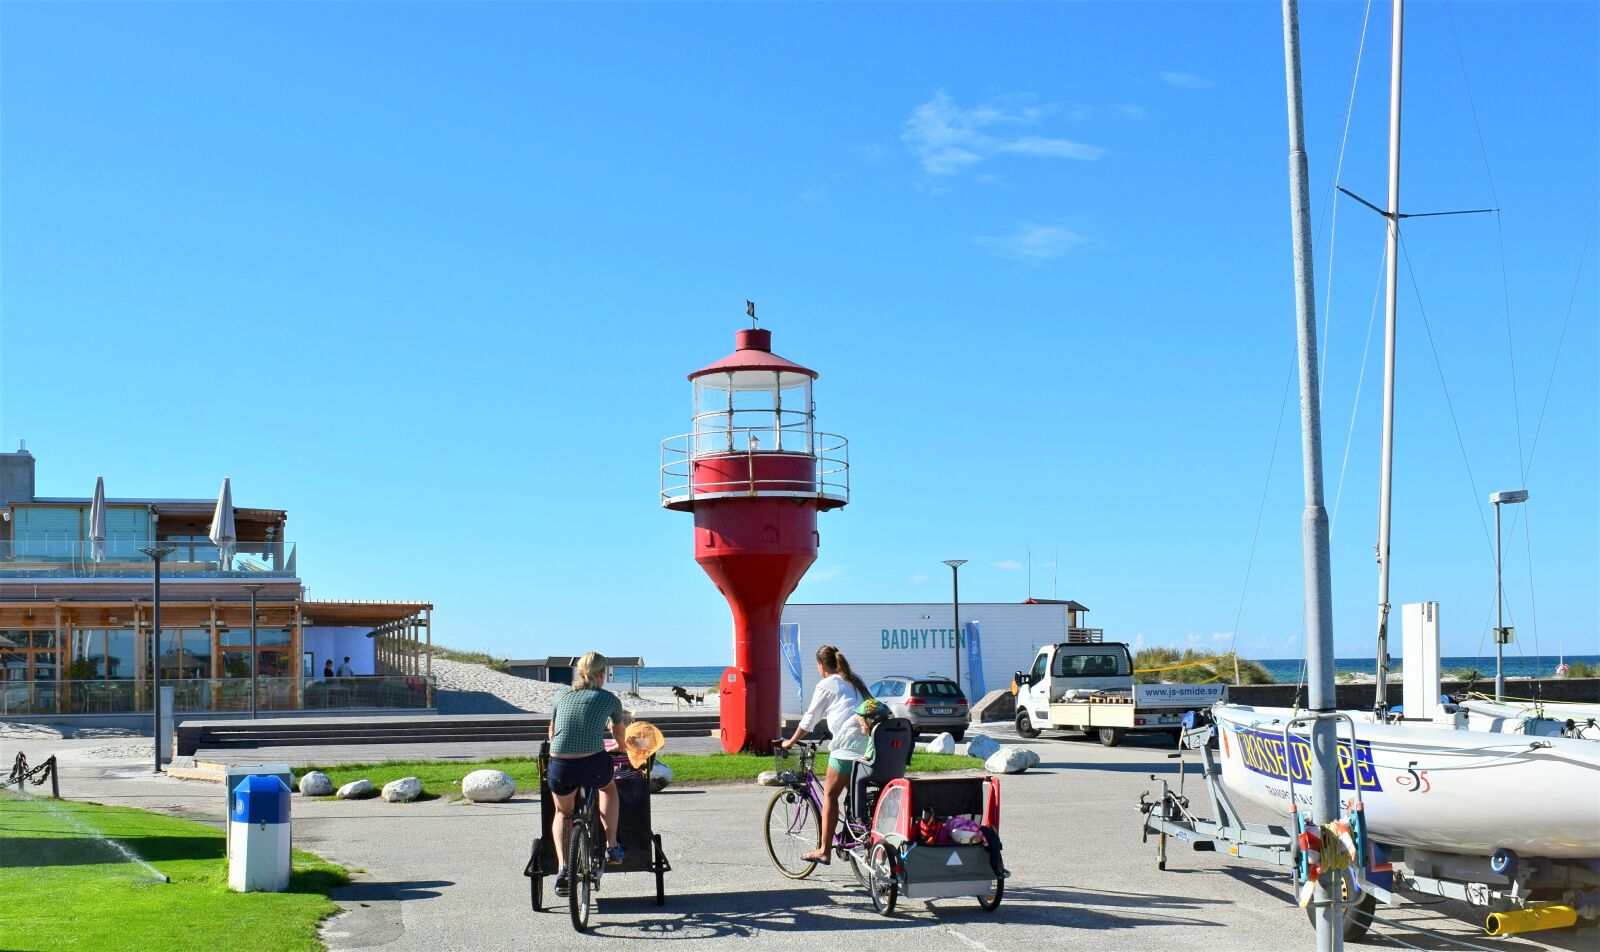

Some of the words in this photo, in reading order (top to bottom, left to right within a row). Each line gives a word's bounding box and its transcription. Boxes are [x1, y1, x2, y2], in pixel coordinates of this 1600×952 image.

[881, 628, 966, 650] BADHYTTEN
[1145, 687, 1218, 698] www.js-smide.se
[1237, 732, 1376, 787] CROSSEURPE
